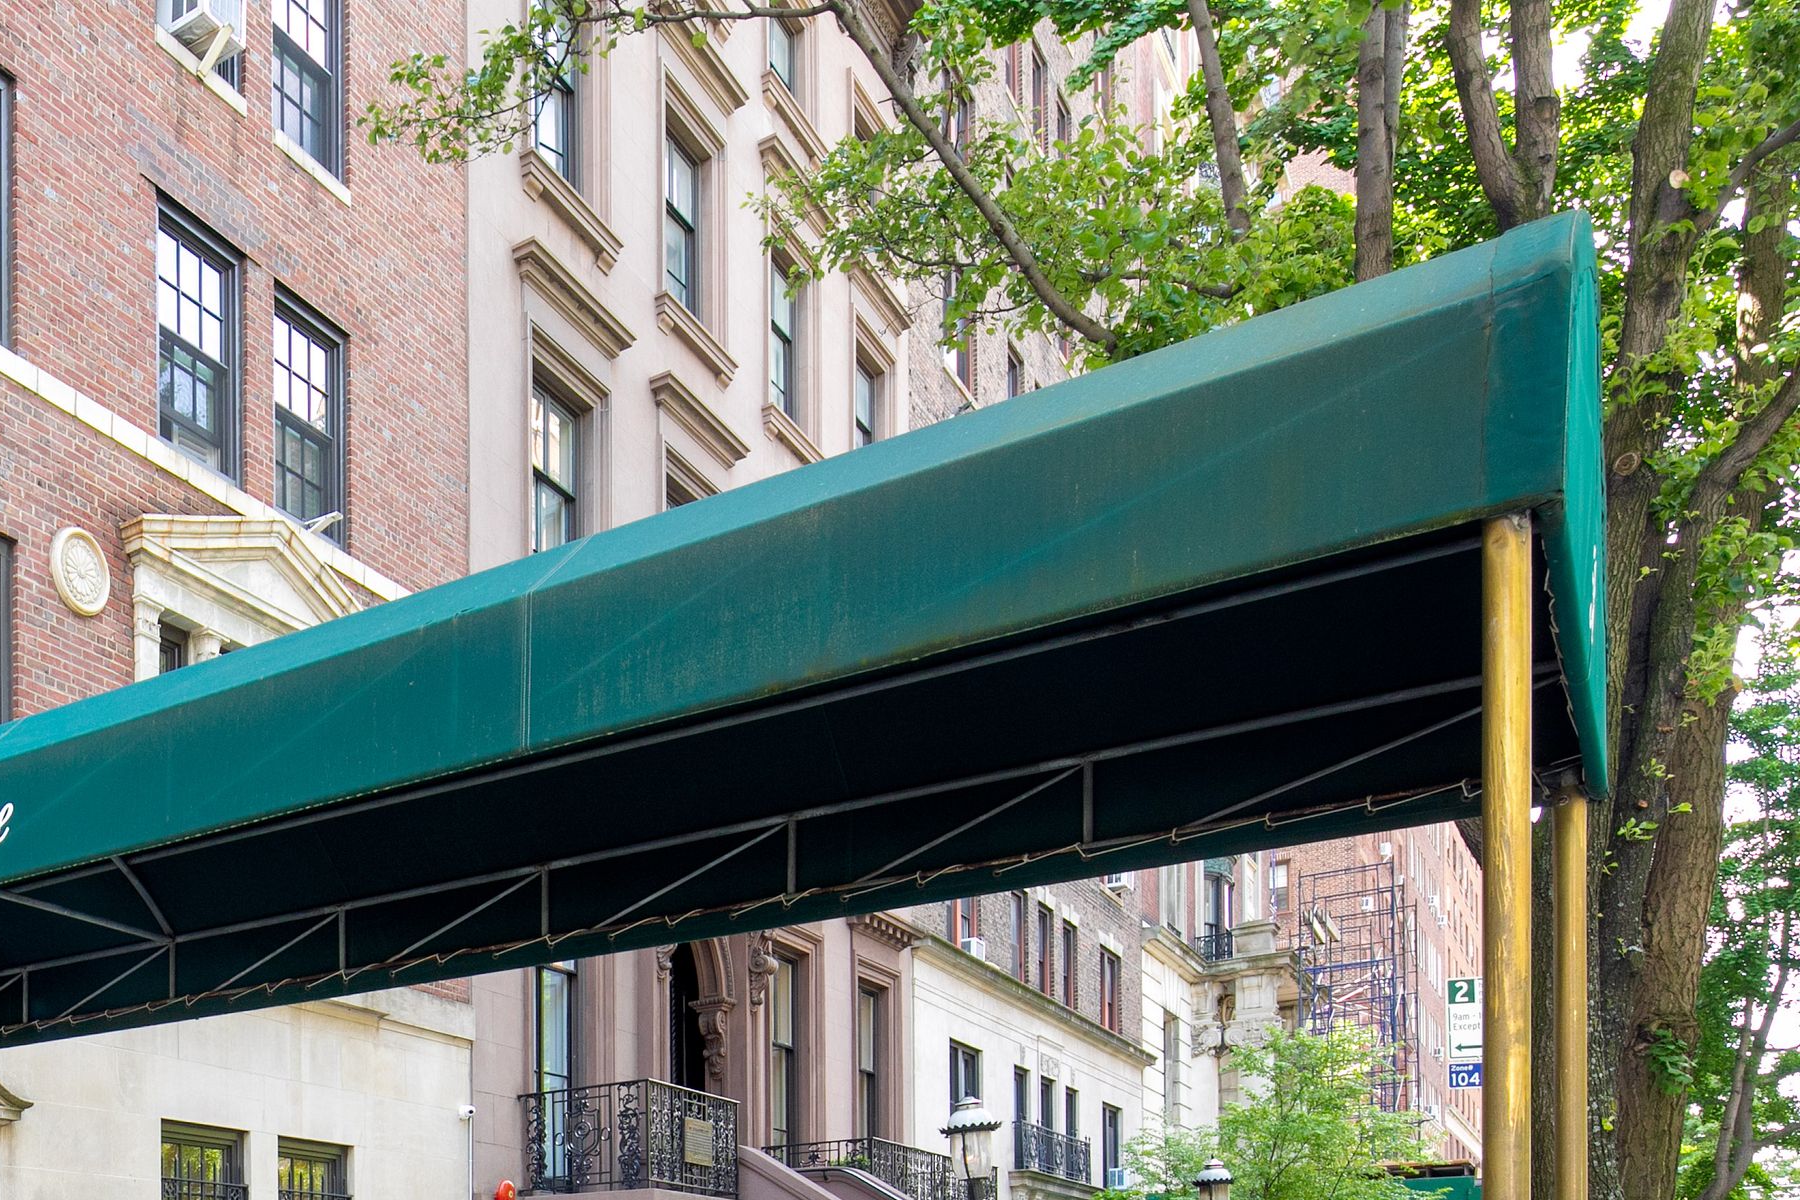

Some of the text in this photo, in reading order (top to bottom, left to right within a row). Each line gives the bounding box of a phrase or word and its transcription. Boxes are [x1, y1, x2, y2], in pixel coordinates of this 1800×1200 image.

[1454, 981, 1469, 1002] 2
[1453, 1012, 1470, 1021] 9am
[1453, 1022, 1480, 1031] Except
[1451, 1072, 1480, 1087] 104
